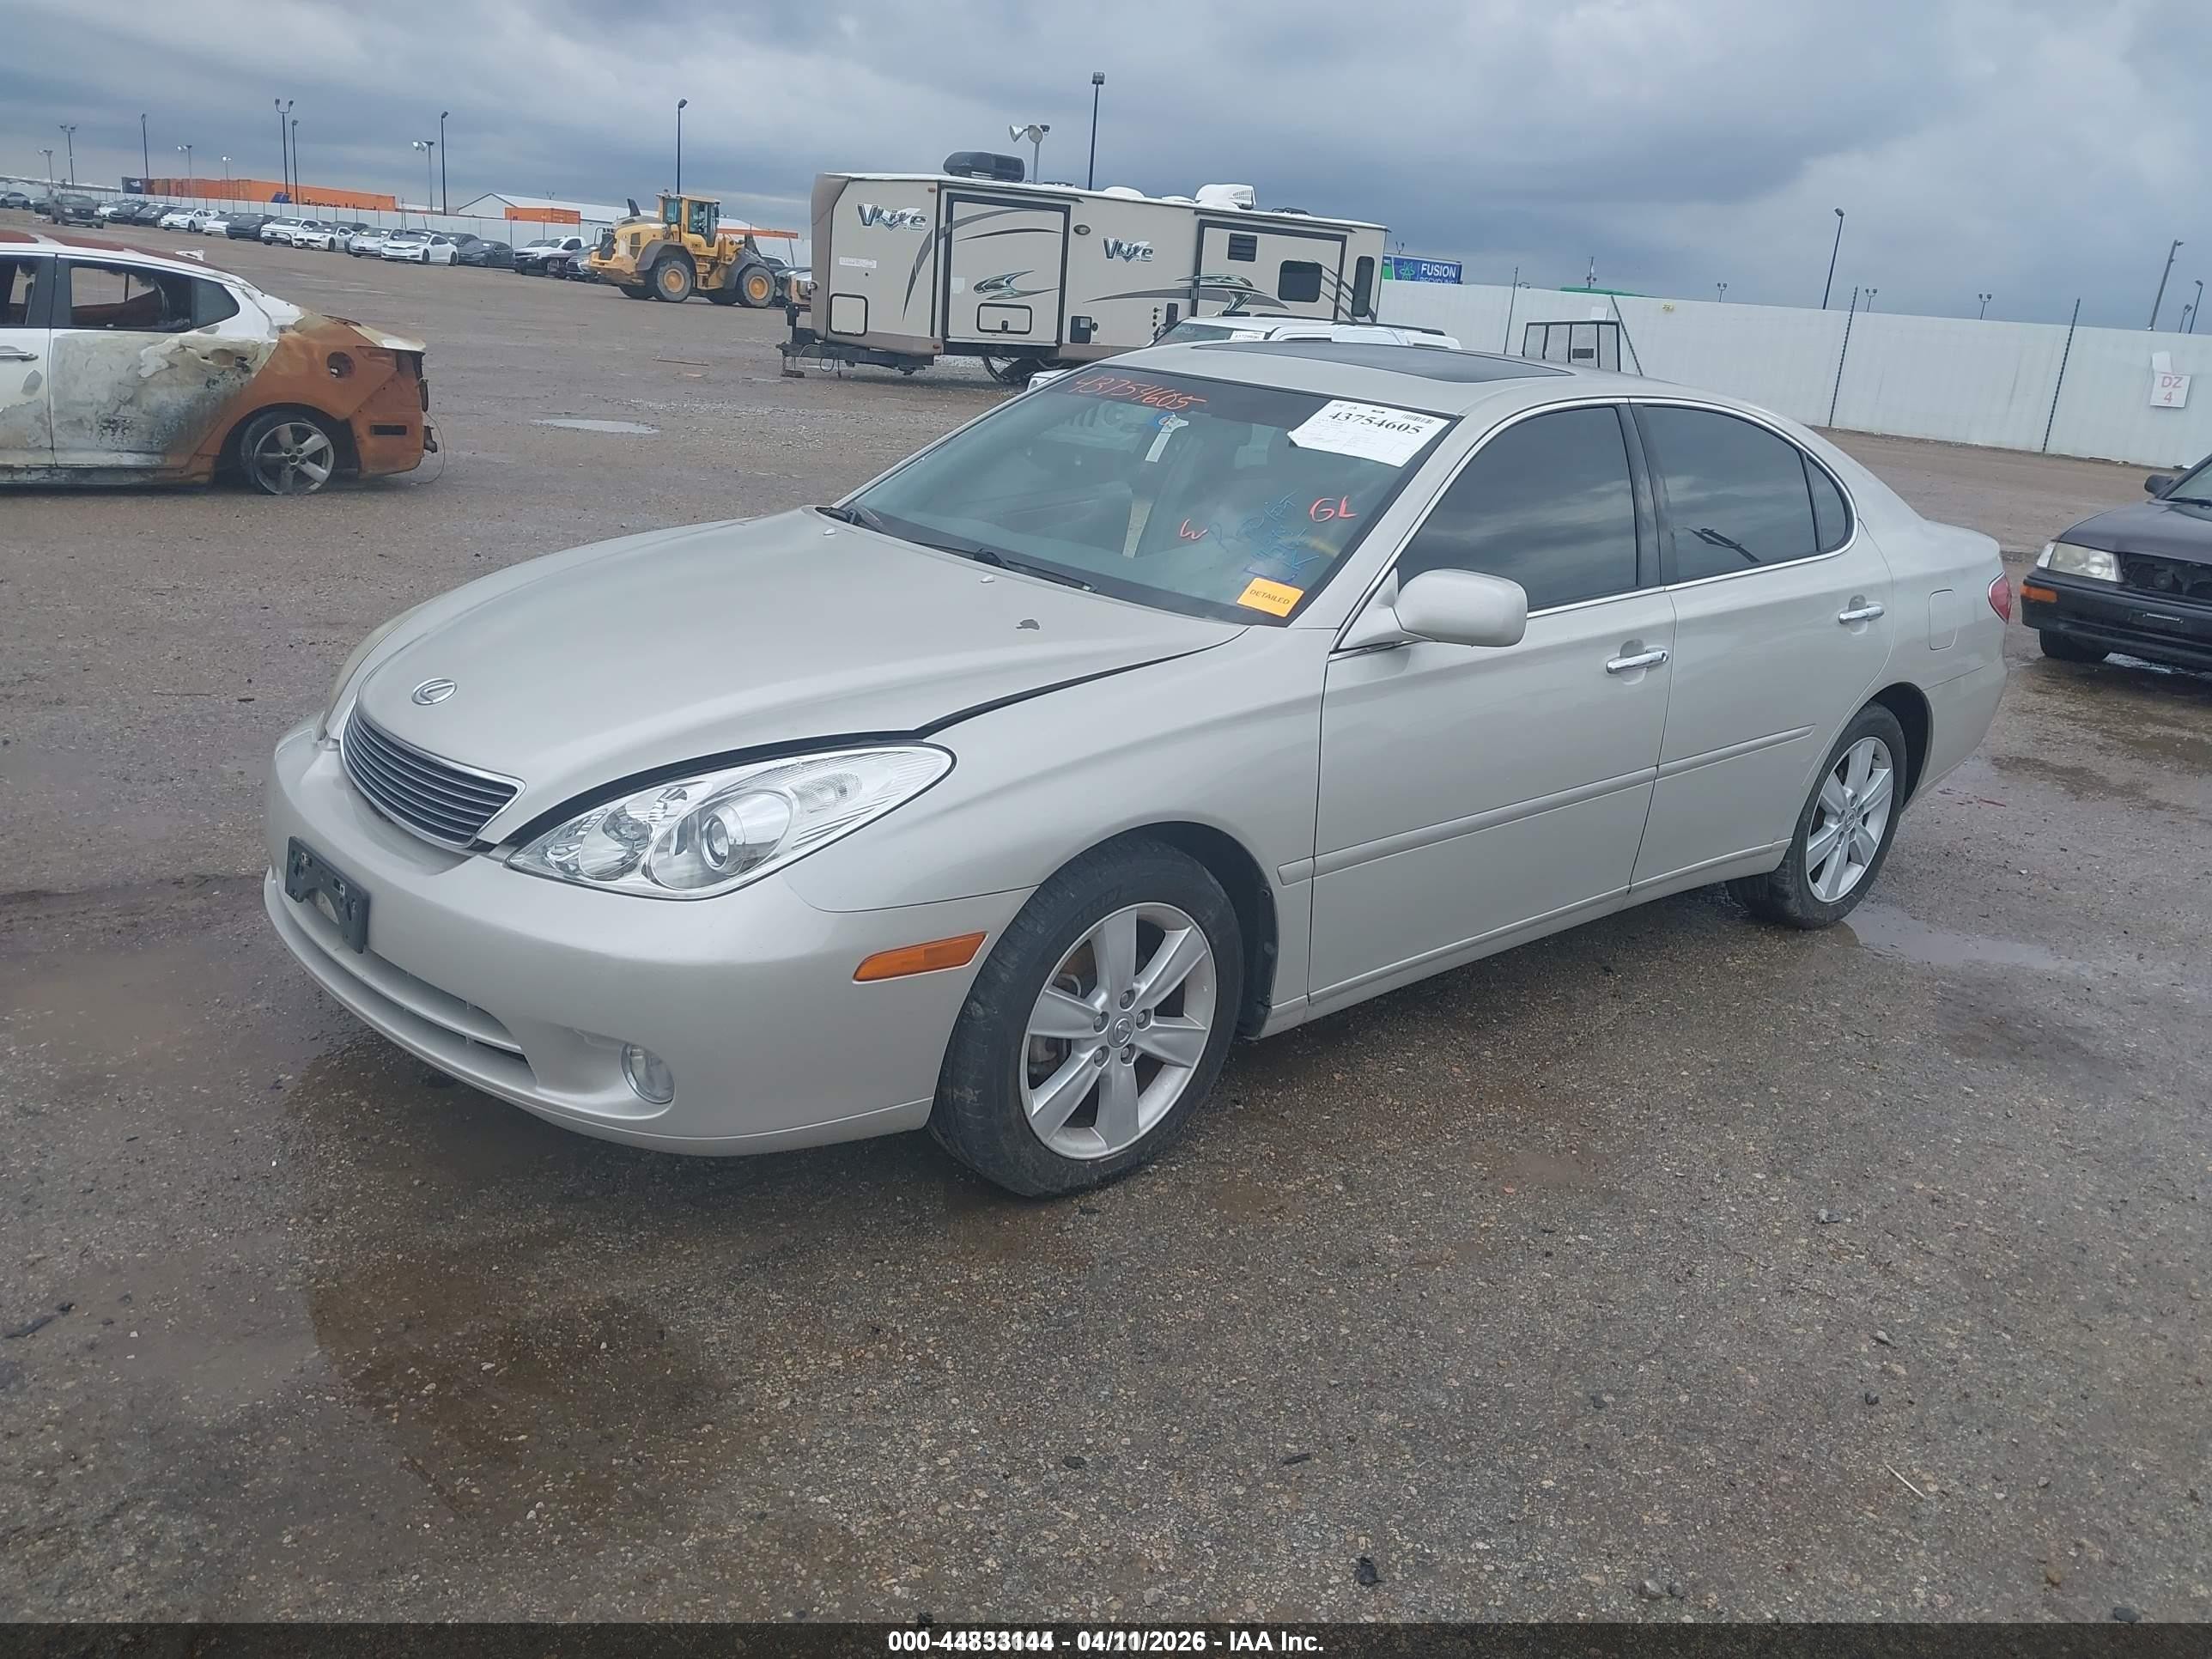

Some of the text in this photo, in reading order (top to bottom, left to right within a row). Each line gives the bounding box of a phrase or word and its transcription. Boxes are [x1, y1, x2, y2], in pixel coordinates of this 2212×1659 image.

[1420, 263, 1457, 278] FUSION
[1068, 376, 1207, 410] 43754605
[2164, 391, 2172, 404] 4
[1329, 411, 1424, 434] 43754605
[1249, 588, 1291, 605] DETAILED
